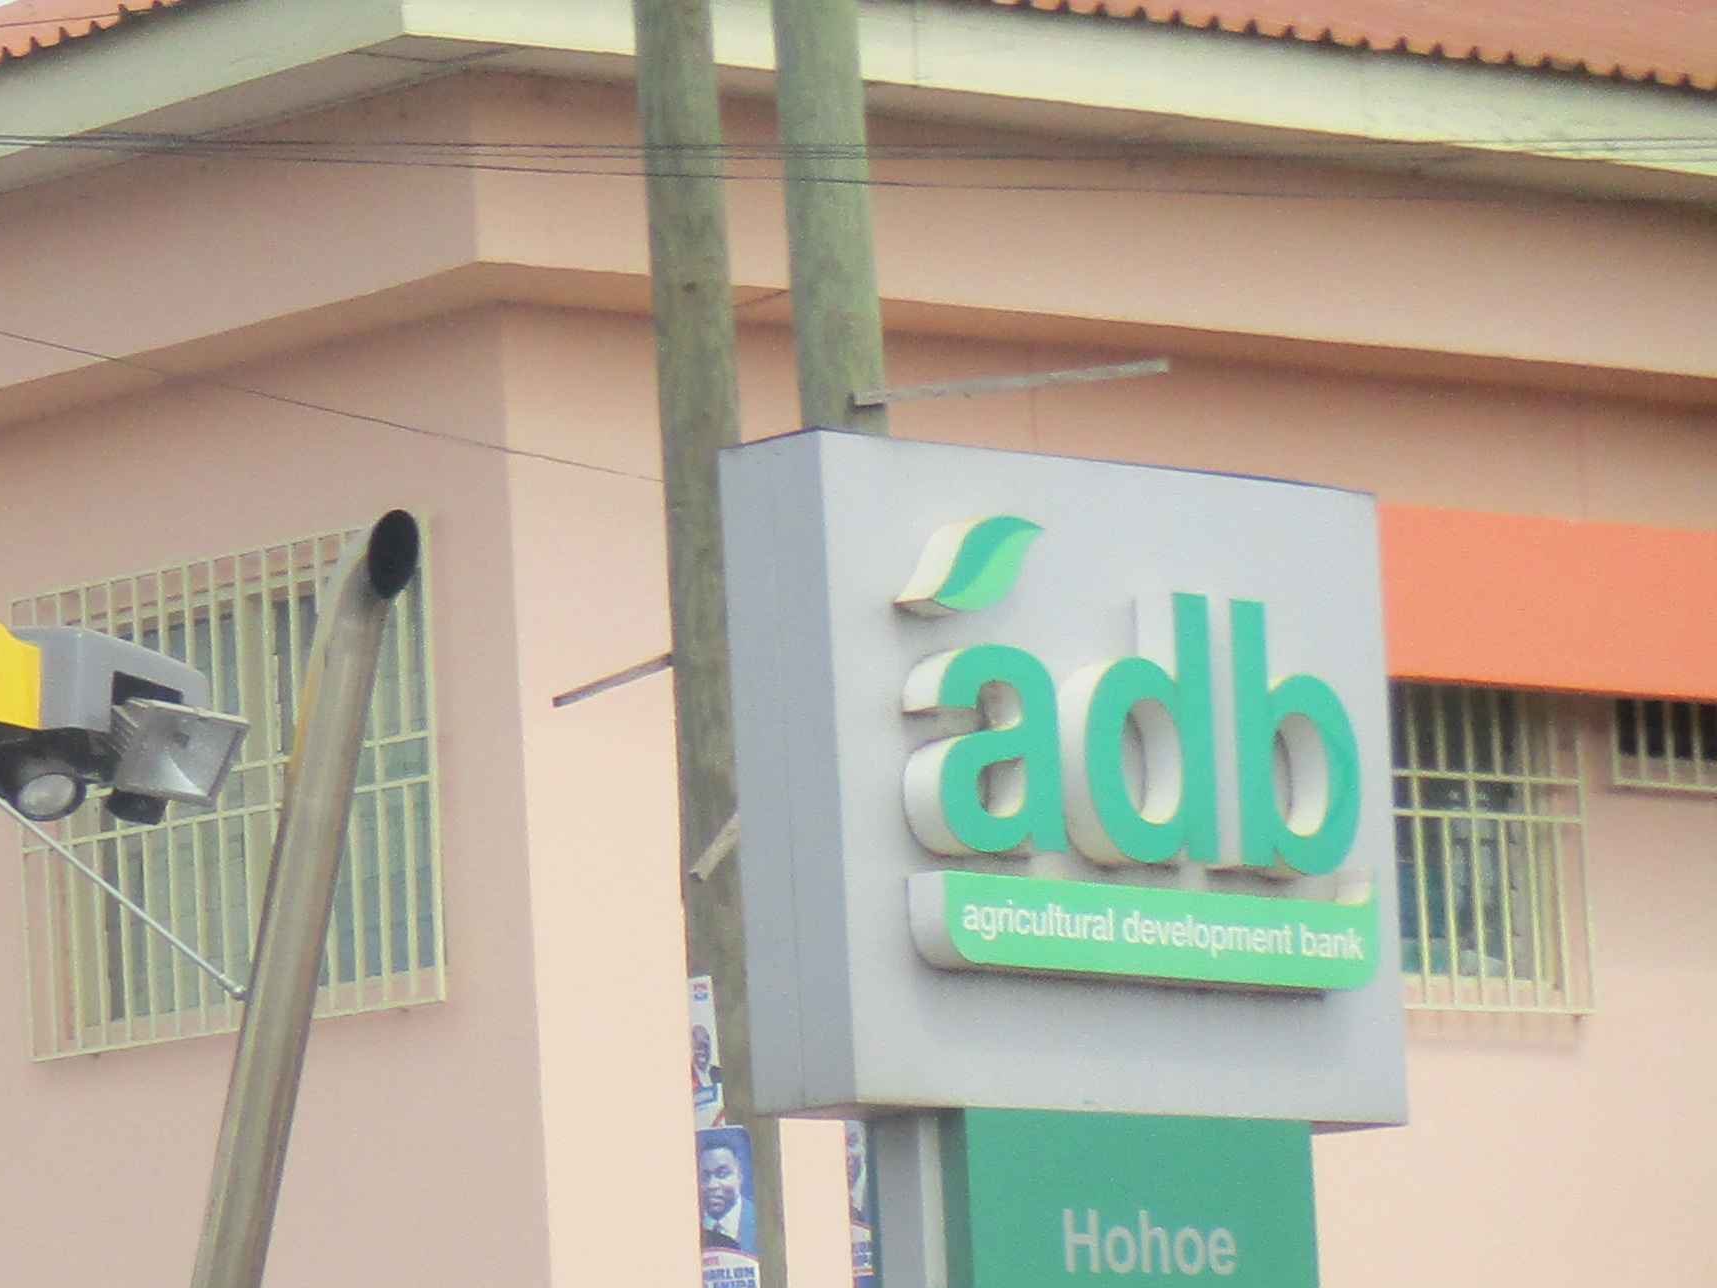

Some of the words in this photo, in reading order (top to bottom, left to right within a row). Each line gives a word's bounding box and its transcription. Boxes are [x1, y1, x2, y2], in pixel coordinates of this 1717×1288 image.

[963, 900, 1114, 941] agricultural
[1121, 911, 1294, 958] development
[1300, 923, 1364, 960] bank
[1062, 1207, 1238, 1276] Hohoe
